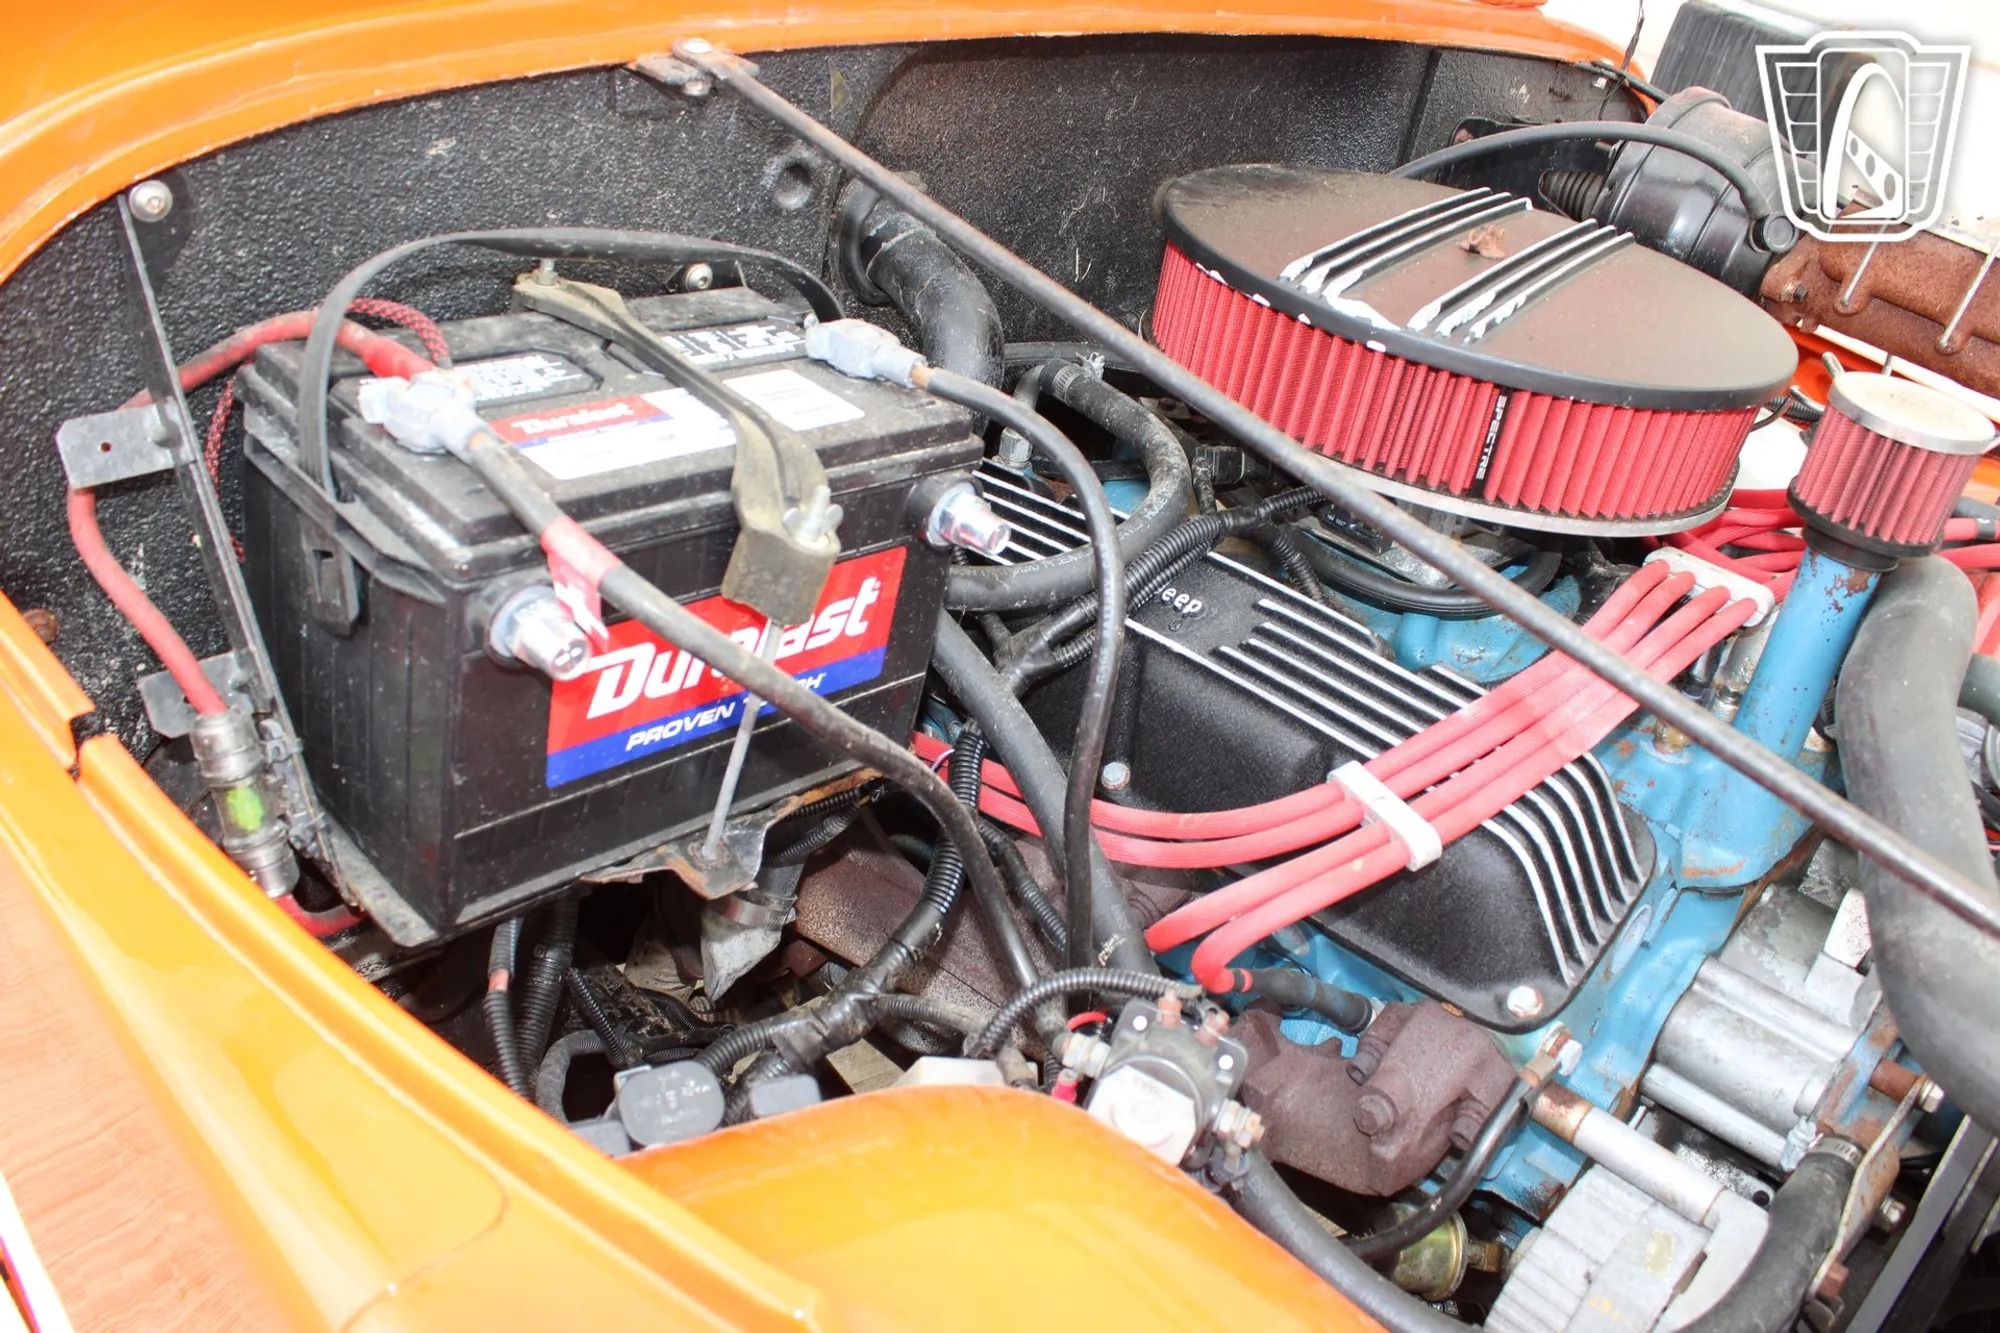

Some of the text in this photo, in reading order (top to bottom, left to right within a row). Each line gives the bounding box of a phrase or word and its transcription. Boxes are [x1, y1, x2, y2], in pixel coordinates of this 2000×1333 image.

[1475, 394, 1508, 480] SPECTRE
[1157, 586, 1203, 614] eep
[625, 701, 736, 752] PROVEN
